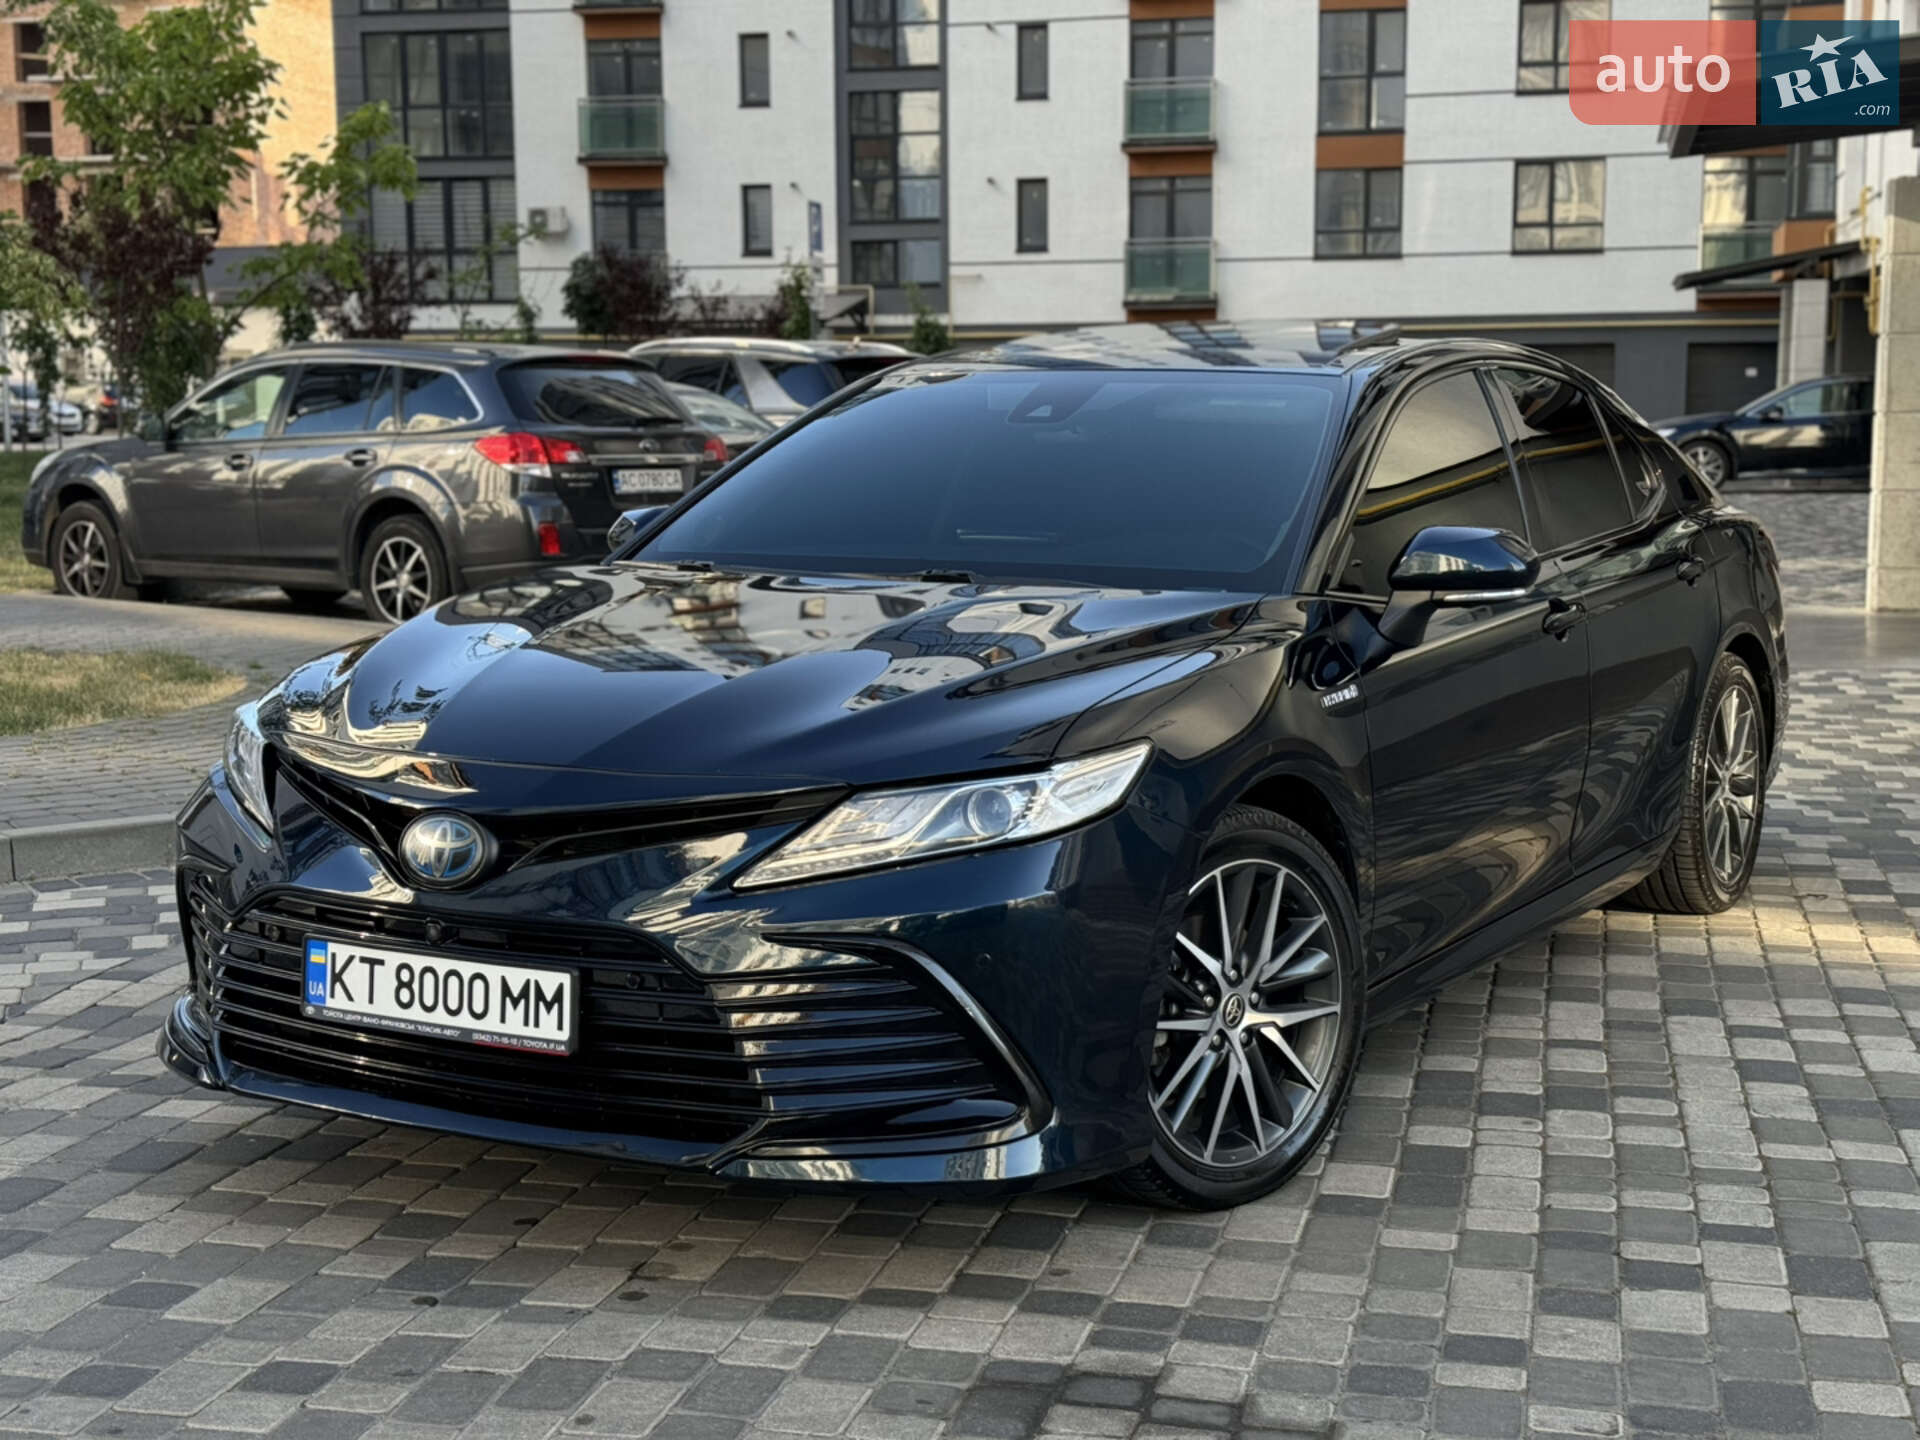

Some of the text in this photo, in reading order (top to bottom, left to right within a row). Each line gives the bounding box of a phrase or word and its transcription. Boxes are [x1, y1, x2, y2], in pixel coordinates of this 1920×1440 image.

[309, 980, 325, 997] UA
[329, 952, 564, 1031] KT 8000 MM
